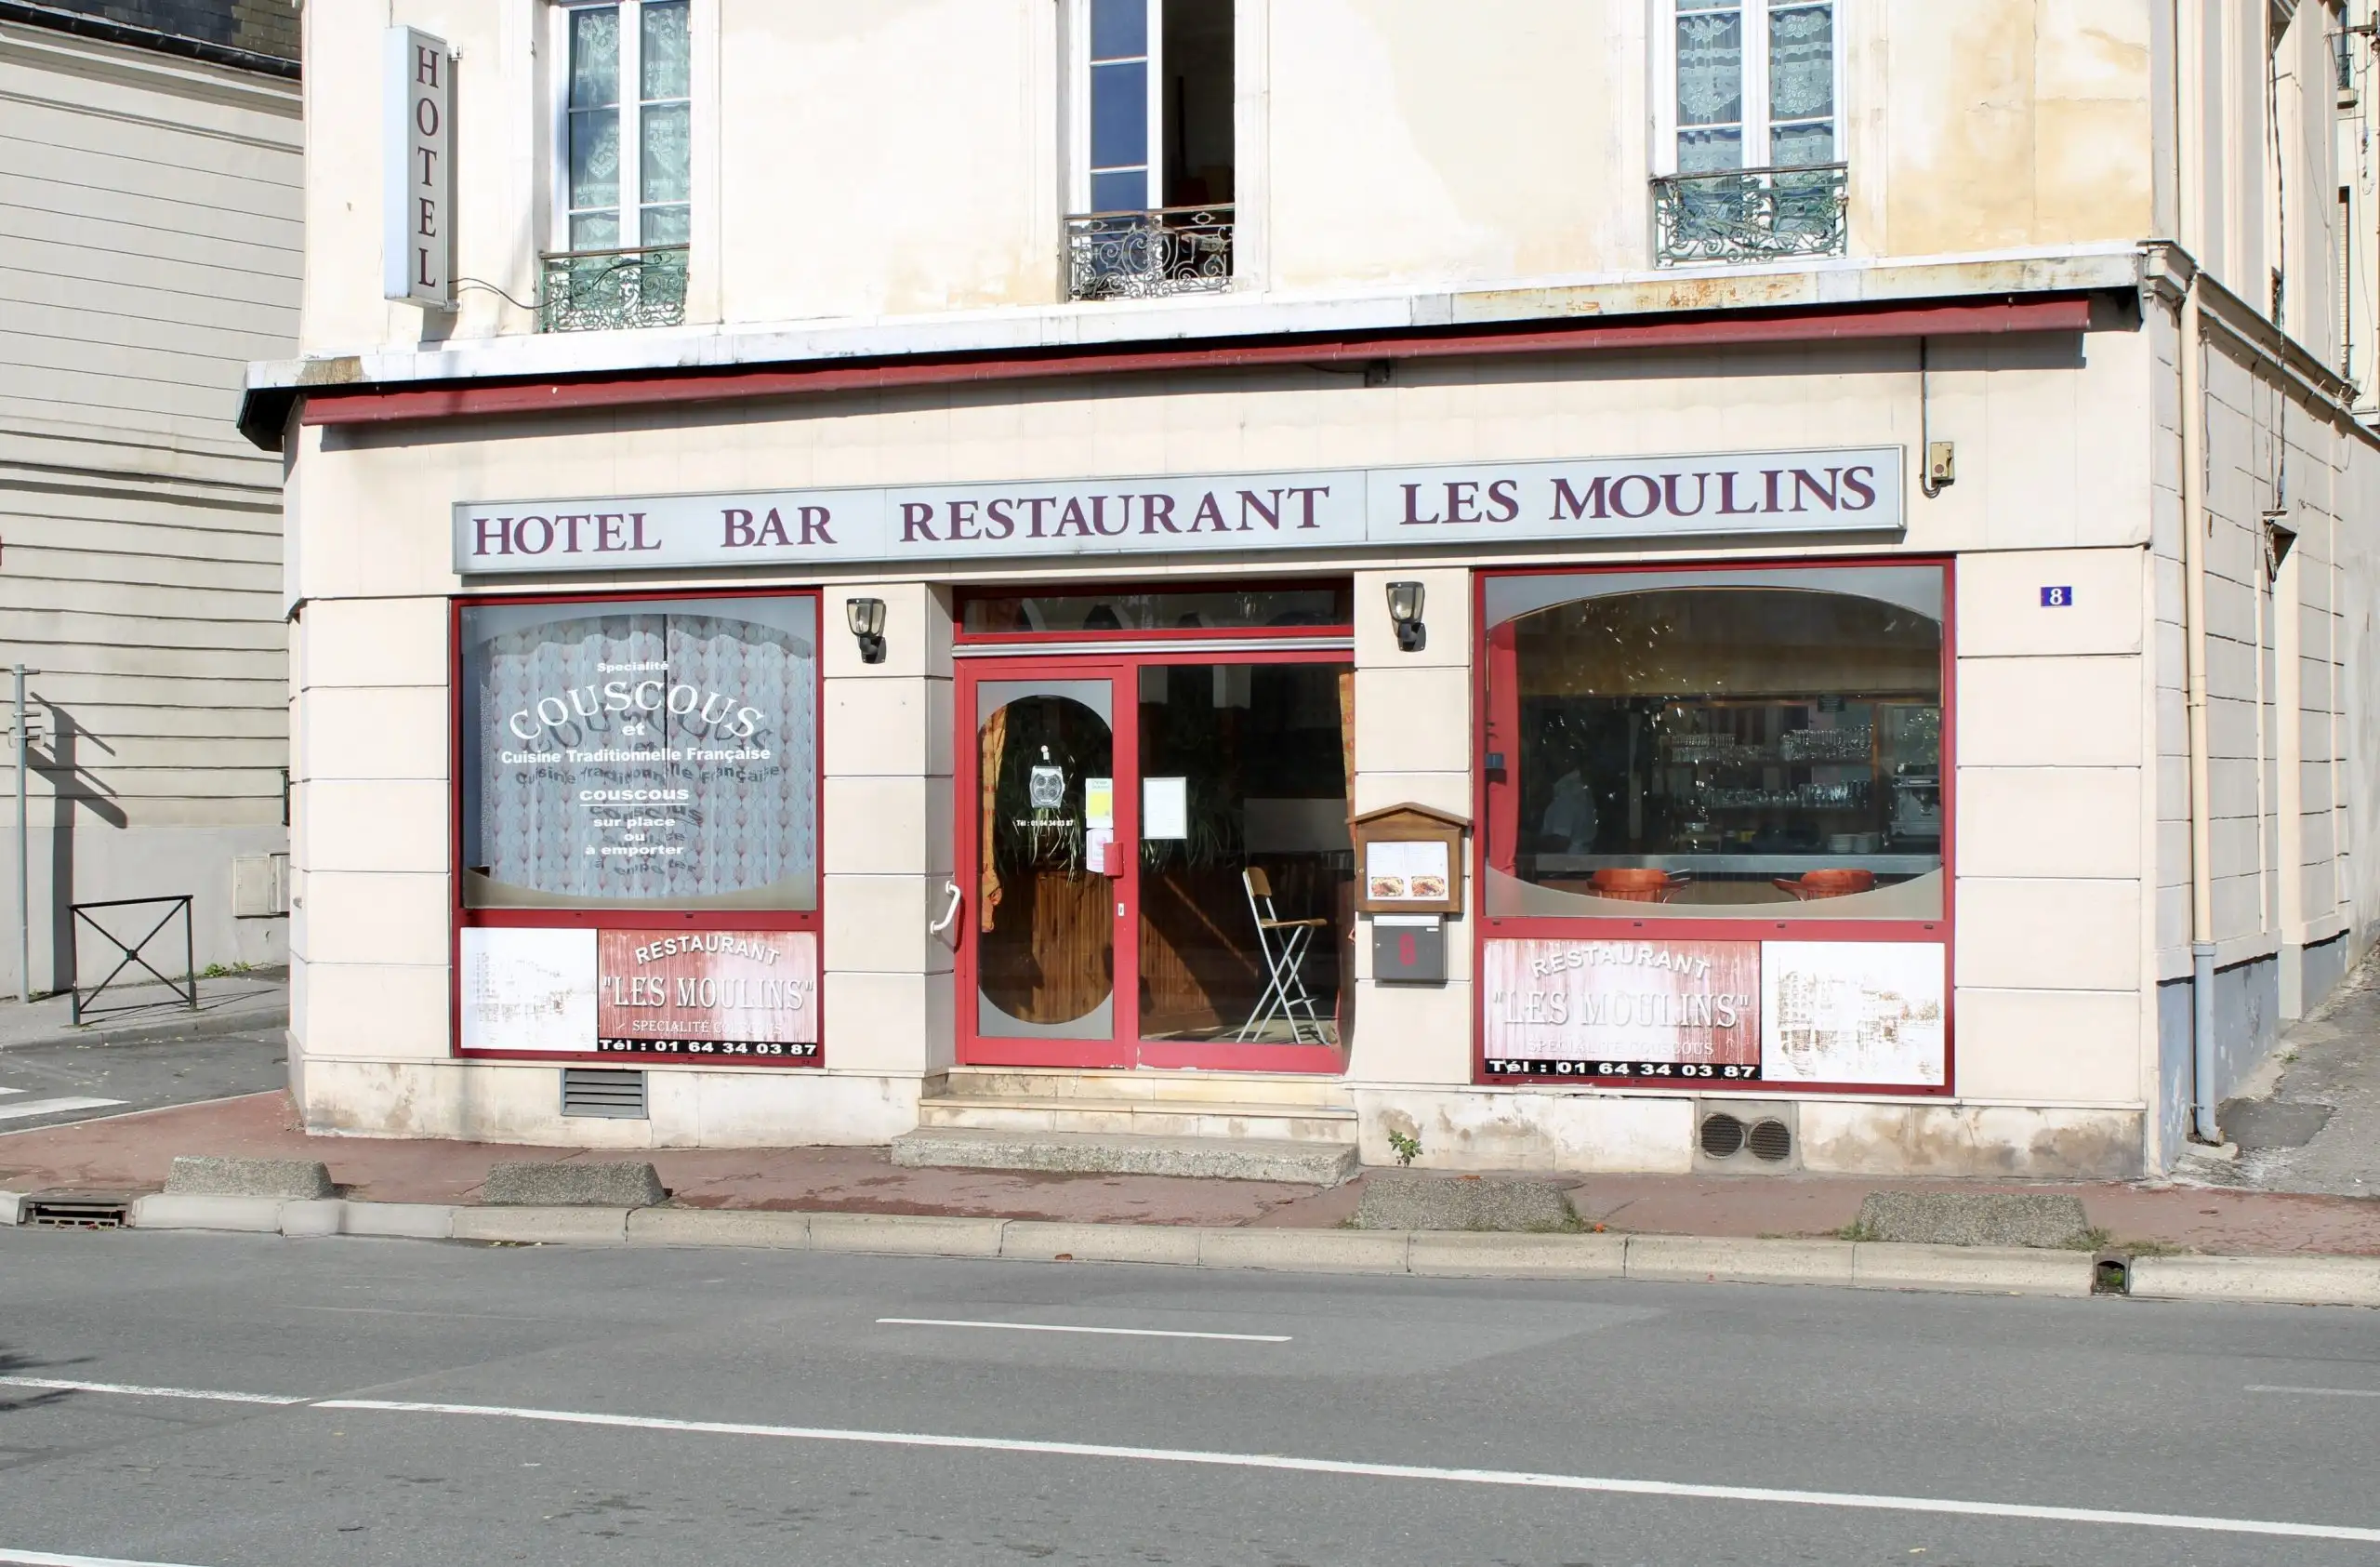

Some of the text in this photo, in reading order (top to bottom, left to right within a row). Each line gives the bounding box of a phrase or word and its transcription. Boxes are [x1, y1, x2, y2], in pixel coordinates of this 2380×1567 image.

[416, 44, 440, 288] HOTEL
[472, 465, 1877, 556] HOTEL BAR RESTAURANT LES MOULINS
[2049, 588, 2063, 605] 8
[597, 660, 670, 674] Specialité
[509, 680, 766, 740] COUSCOUS
[622, 723, 645, 737] et
[501, 747, 771, 764] Cuisine Traditionnelle Française
[579, 788, 690, 802] couscous
[593, 816, 676, 830] sur place
[624, 832, 645, 843] ou
[585, 843, 684, 858] à emporter
[634, 934, 781, 965] RESTAURANT
[1399, 932, 1416, 965] 8
[1531, 943, 1712, 979] RESTAURANT
[599, 1039, 632, 1051] Tél
[654, 1041, 680, 1052] 01
[688, 1042, 714, 1053] 64
[722, 1042, 748, 1054] 34
[756, 1042, 783, 1055] 03
[790, 1043, 817, 1056] 87
[1488, 1059, 1529, 1073] Tél
[1557, 1061, 1586, 1074] 01
[1597, 1062, 1631, 1075] 64
[1640, 1063, 1672, 1076] 34
[1681, 1064, 1713, 1077] 03
[1723, 1065, 1756, 1079] 87
